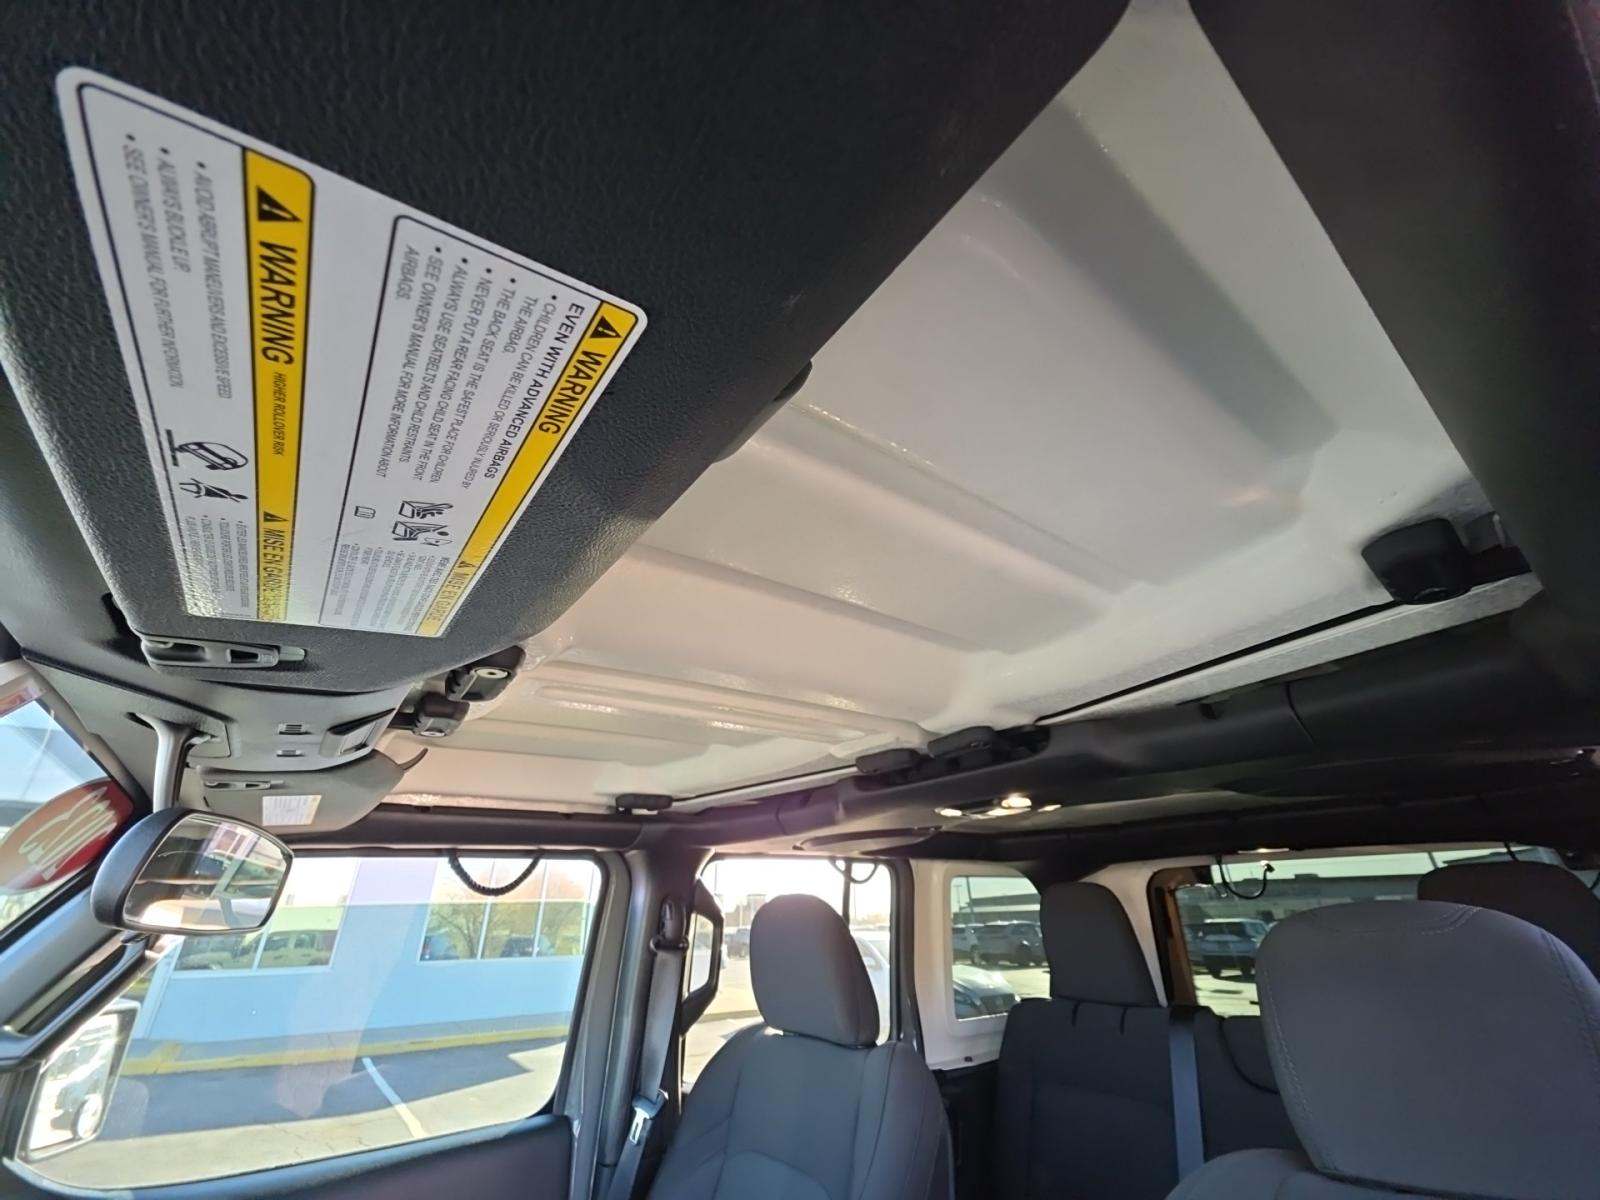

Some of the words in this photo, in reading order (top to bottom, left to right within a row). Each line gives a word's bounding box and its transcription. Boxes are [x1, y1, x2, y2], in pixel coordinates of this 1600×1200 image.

[164, 210, 188, 255] BUCKLE
[141, 233, 162, 272] MANUAL
[424, 256, 443, 282] SEE
[149, 276, 168, 298] FOR
[198, 212, 219, 257] ABRUPT
[211, 333, 229, 375] EXCESSIVE
[444, 266, 467, 311] ALWAYS
[469, 278, 492, 316] NEVER
[496, 288, 515, 310] THE
[260, 242, 296, 364] WARNING
[412, 283, 436, 332] OWNER'S
[518, 296, 538, 317] THE
[437, 312, 454, 334] USE
[462, 315, 478, 337] PUT
[486, 310, 506, 338] BACK
[525, 303, 556, 351] CHILDREN
[554, 303, 584, 343] EVEN
[402, 332, 423, 368] MANUAL
[459, 336, 470, 345] A
[477, 338, 494, 362] SEAT
[422, 334, 447, 383] SEATBELTS
[451, 345, 468, 370] REAR
[472, 362, 485, 372] IS
[516, 352, 532, 371] CAN
[536, 346, 562, 378] WITH
[273, 372, 286, 402] HIGHER
[398, 370, 413, 389] FOR
[440, 370, 459, 400] FACING
[466, 373, 481, 389] THE
[509, 371, 524, 384] BE
[392, 389, 408, 413] MORE
[418, 383, 432, 401] AND
[498, 383, 517, 409] KILLED
[539, 351, 605, 433] WARNING
[410, 401, 426, 423] CHILD
[432, 400, 448, 422] CHILD
[456, 390, 474, 419] SAFEST
[492, 410, 505, 422] OR
[506, 379, 542, 438] ADVANCED
[273, 403, 285, 440] ROLLOVER
[427, 422, 440, 440] SEAT
[446, 418, 463, 440] PLACE
[382, 413, 401, 457] INFORMATION
[441, 440, 454, 454] FOR
[476, 422, 499, 457] SERIOUSLY
[272, 440, 284, 455] RISK
[419, 448, 432, 461] THE
[484, 439, 511, 478] AIRBAGS
[376, 457, 389, 477] ABOUT
[464, 457, 482, 481] INJURED
[460, 481, 470, 489] BY
[263, 528, 285, 552] MISE
[263, 552, 284, 565] EN
